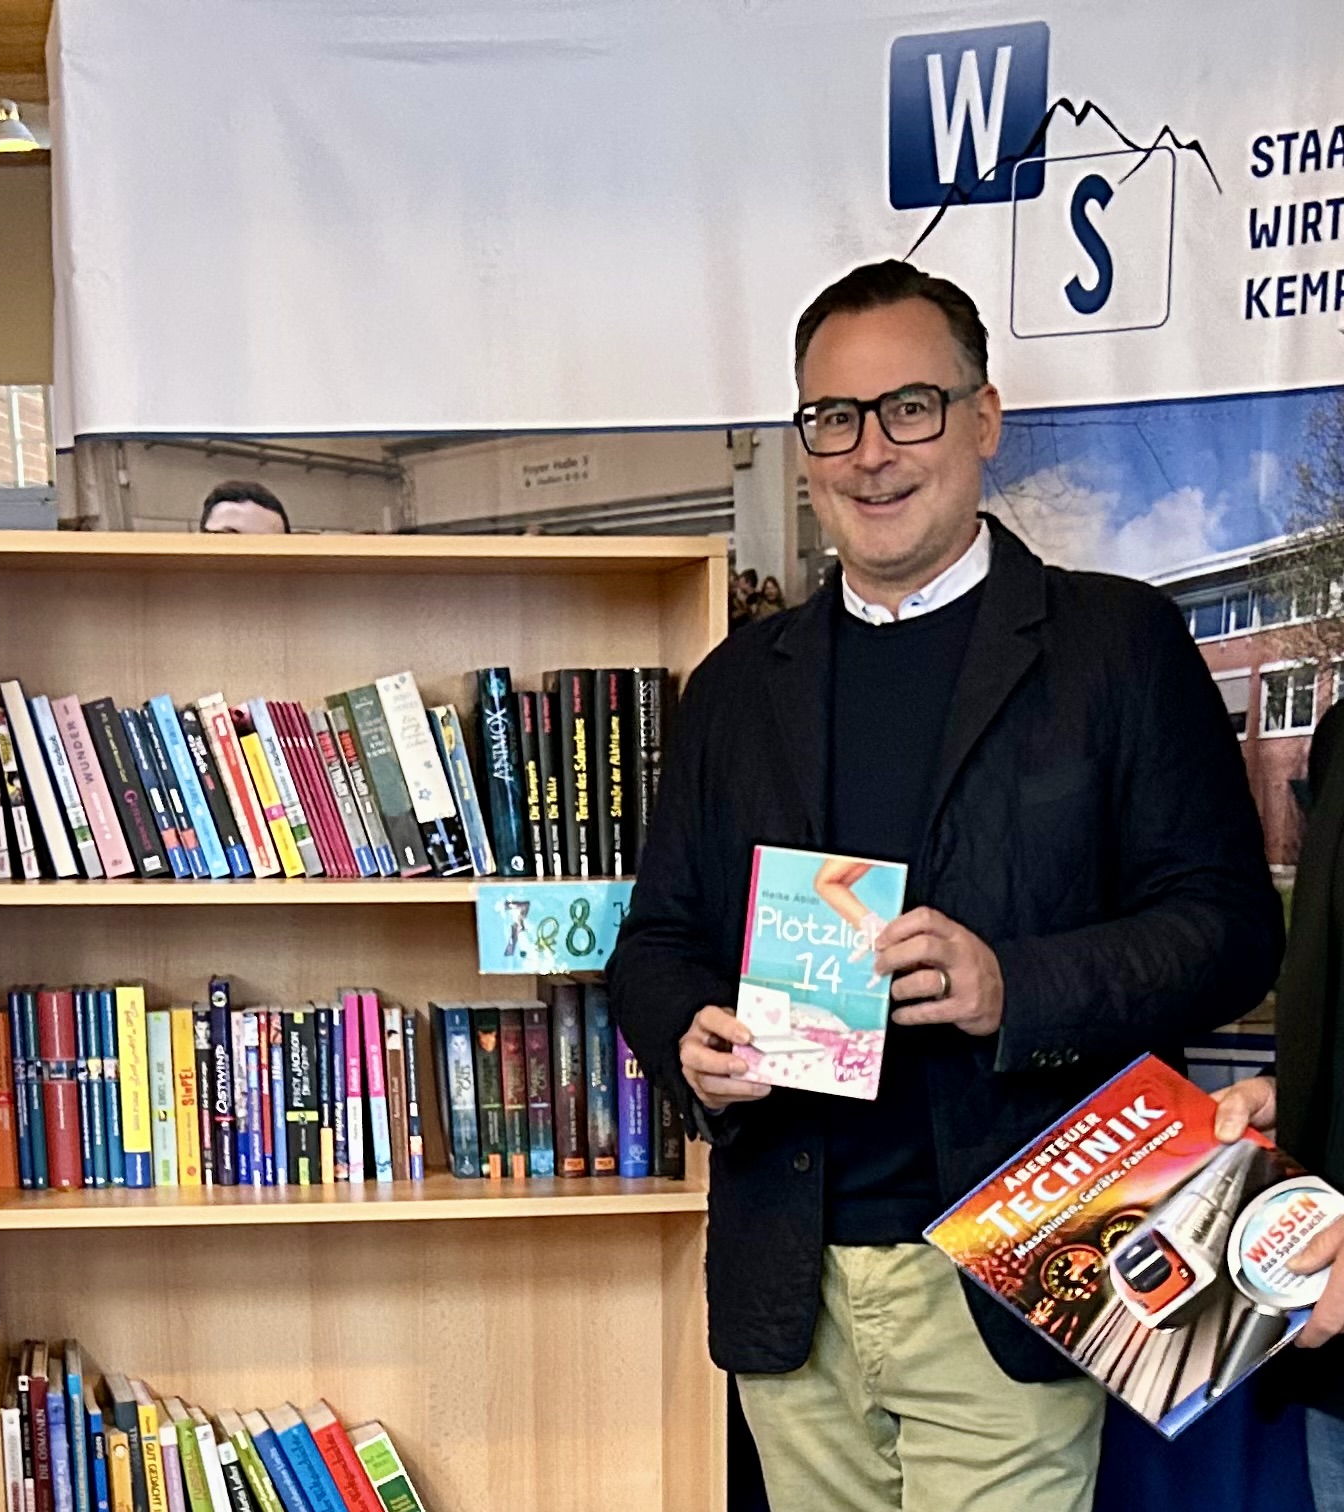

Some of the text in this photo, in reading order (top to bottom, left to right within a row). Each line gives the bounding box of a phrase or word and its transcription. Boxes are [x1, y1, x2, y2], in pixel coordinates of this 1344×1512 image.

[926, 45, 1012, 185] W
[1064, 173, 1115, 315] S
[66, 720, 95, 785] WUNDER
[756, 905, 884, 954] Plötzlich
[793, 950, 843, 995] 14
[214, 1045, 227, 1113] OSTWIND
[976, 1094, 1168, 1240] TECHNIK
[1003, 1111, 1103, 1192] ABENTEUER
[1013, 1119, 1186, 1262] Maschinen, Geräte, Fahrzeuge
[1245, 1193, 1319, 1263] WISSEN
[1260, 1210, 1330, 1274] das Spaß macht
[146, 1442, 158, 1461] GUT
[148, 1463, 163, 1507] GEDACHT
